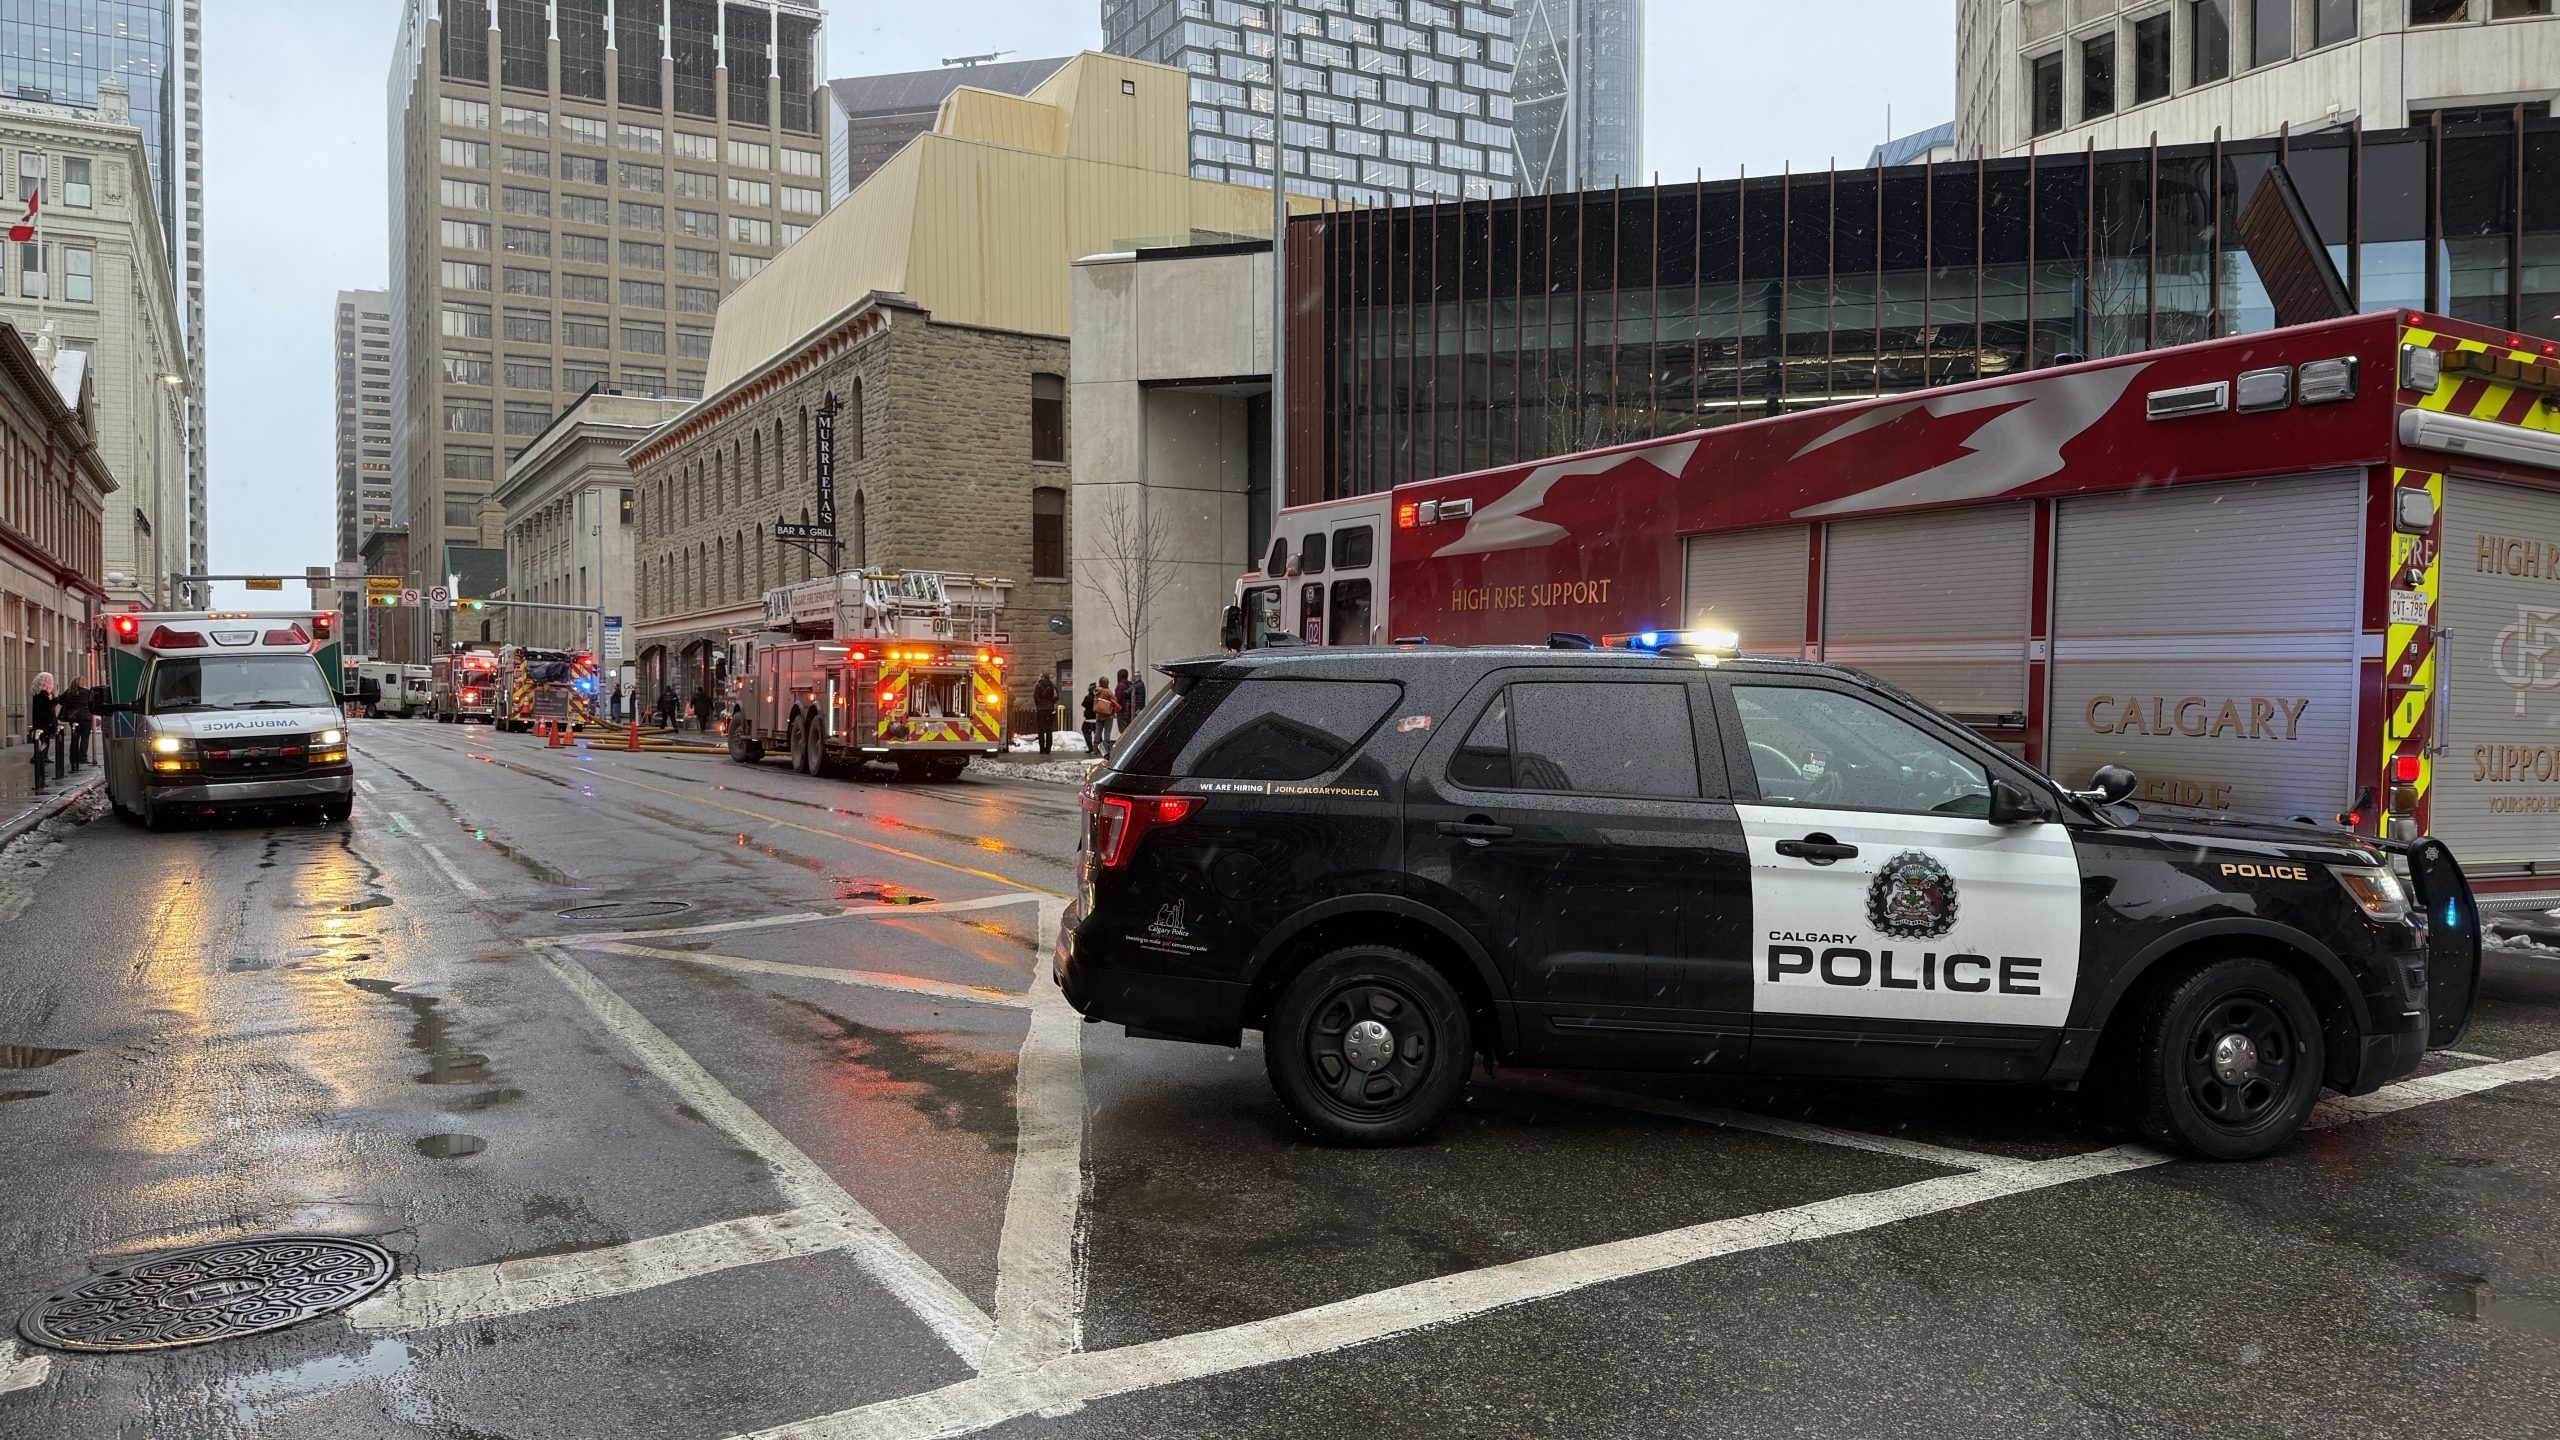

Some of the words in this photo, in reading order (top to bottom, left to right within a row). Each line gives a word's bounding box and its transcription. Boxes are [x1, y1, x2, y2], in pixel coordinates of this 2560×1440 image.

[818, 416, 833, 524] MURRIETA'S
[777, 525, 795, 536] BAR
[798, 526, 806, 536] &
[809, 527, 833, 537] GRILL
[2398, 536, 2434, 567] FIRE
[2475, 533, 2541, 578] HIGH
[1451, 587, 1490, 612] HIGH
[1494, 585, 1526, 610] RISE
[1531, 579, 1612, 608] SUPPORT
[2392, 600, 2428, 617] CVT-7987
[935, 620, 945, 632] 01
[1308, 623, 1319, 643] 02
[2039, 644, 2045, 653] 5
[2085, 695, 2310, 740] CALGARY
[1200, 783, 1213, 791] WE
[1215, 783, 1231, 791] ARE
[1233, 784, 1263, 792] HIRING
[1274, 786, 1379, 797] JOIN.CALGARYPOLICE.CA
[2488, 796, 2523, 813] YOURS
[2525, 796, 2546, 813] FOR
[2220, 863, 2309, 881] POLICE
[1148, 924, 1171, 935] Calgary
[1171, 928, 1189, 937] Police
[1768, 931, 1858, 945] CALGARY
[1767, 944, 2043, 996] POLICE
